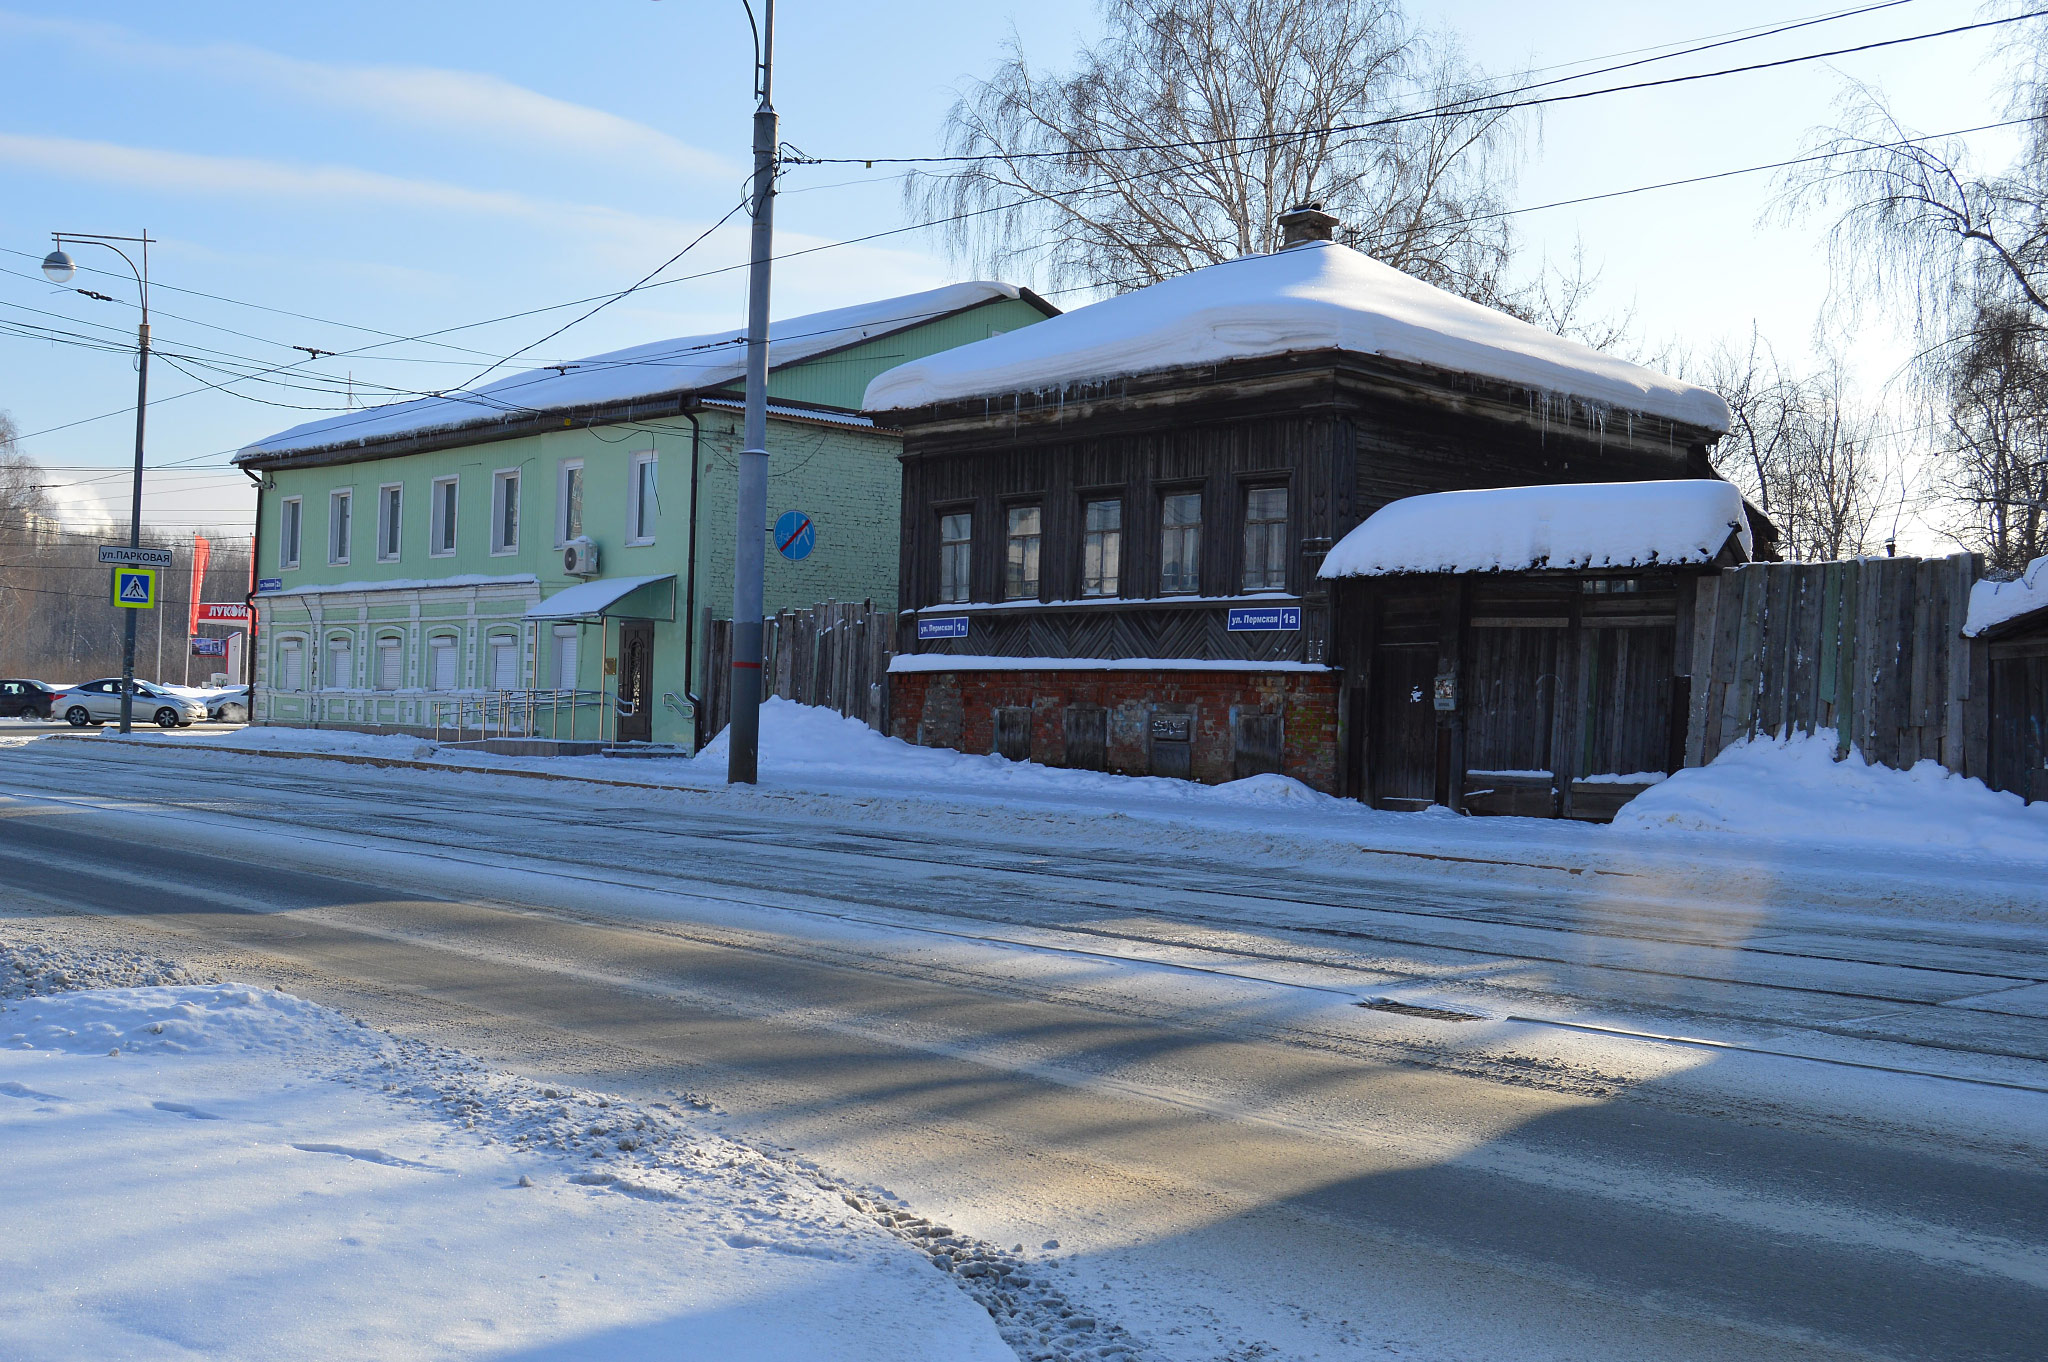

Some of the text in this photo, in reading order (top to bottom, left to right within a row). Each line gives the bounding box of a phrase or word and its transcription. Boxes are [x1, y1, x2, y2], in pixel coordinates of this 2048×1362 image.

[208, 605, 249, 617] ЛУКОЙ
[1231, 612, 1296, 626] ул. Пермская 1а
[920, 626, 928, 635] ул.
[929, 624, 953, 633] Пермская
